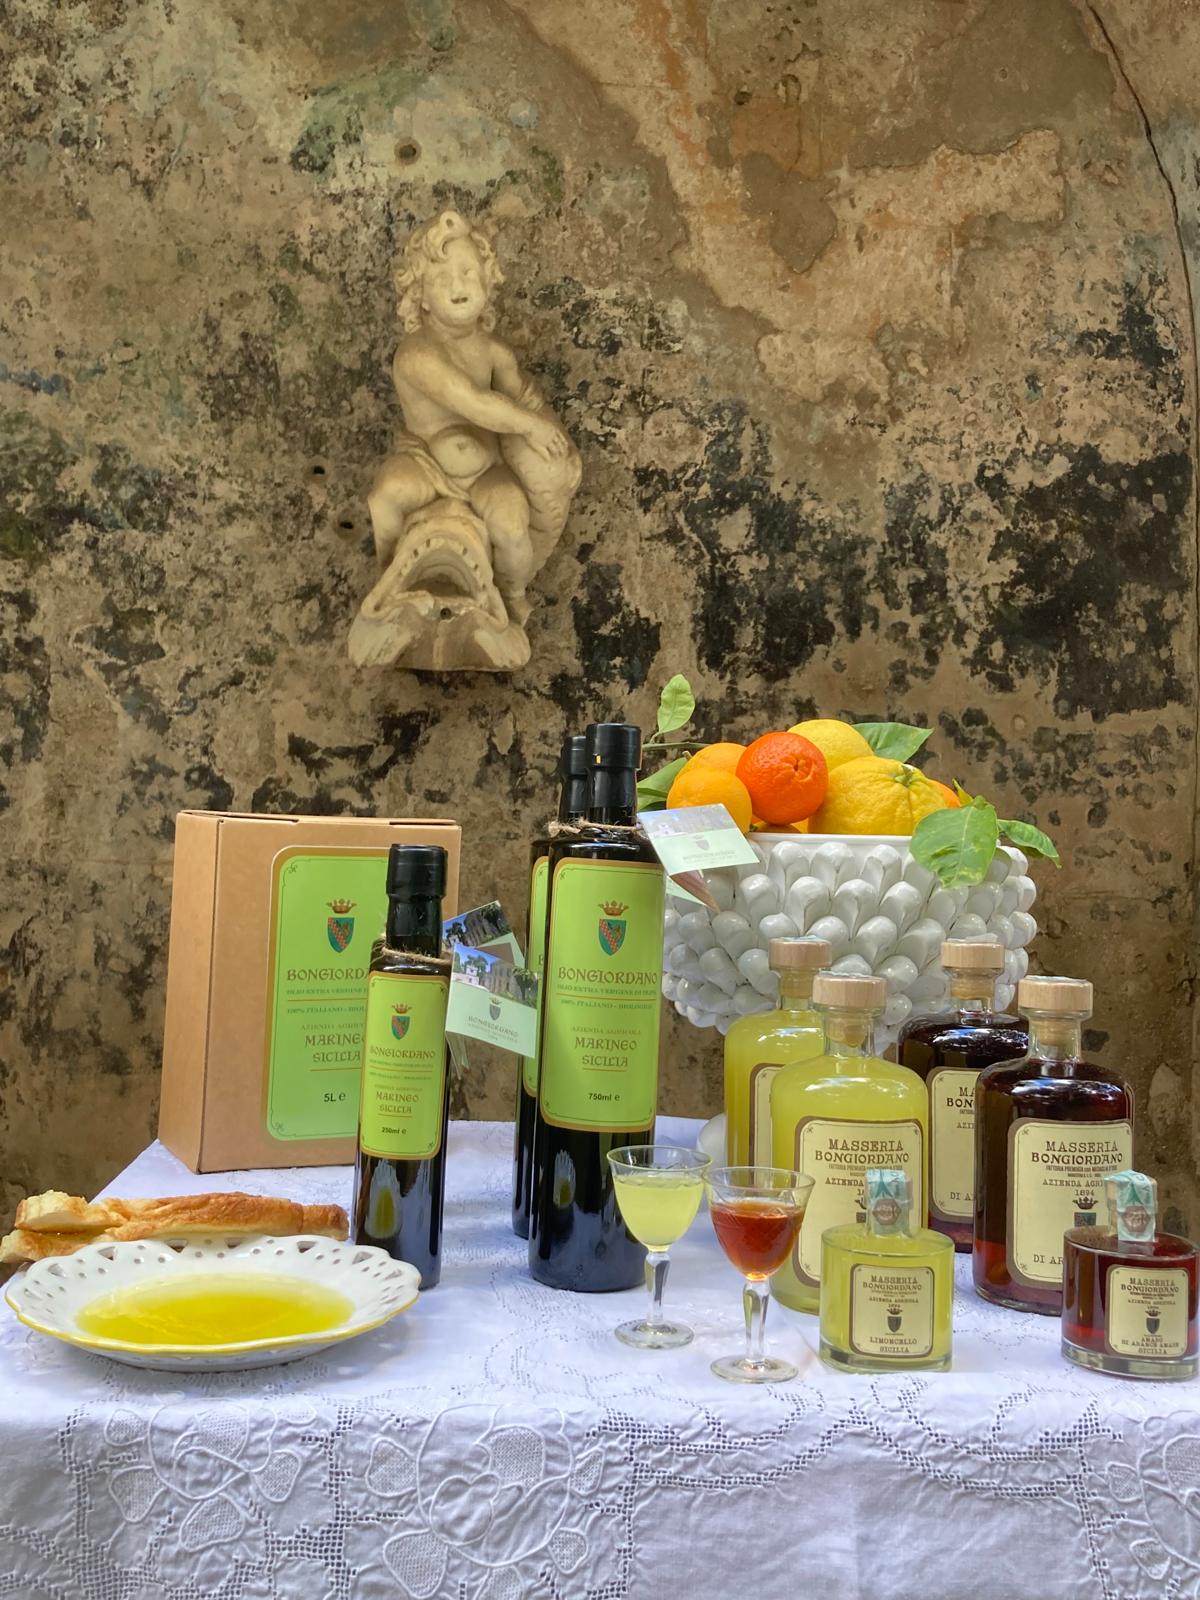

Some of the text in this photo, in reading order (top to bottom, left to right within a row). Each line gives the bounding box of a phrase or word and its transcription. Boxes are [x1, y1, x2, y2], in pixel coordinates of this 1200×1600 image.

[558, 966, 658, 986] BONGIORDANO
[575, 1036, 637, 1051] MARINEO
[313, 1051, 361, 1062] SICILIA
[370, 1045, 436, 1059] BONGIORDANO
[582, 1055, 628, 1067] SICILIA
[324, 1093, 337, 1103] 5L
[376, 1091, 420, 1102] MARINEO
[588, 1092, 612, 1101] 750ml
[379, 1104, 412, 1113] SICILIA
[828, 1138, 904, 1152] MASSERIA
[1046, 1141, 1118, 1153] MASSERIA
[815, 1150, 910, 1164] BONGIORDANO
[1031, 1152, 1123, 1165] BONGIORDANO
[825, 1177, 864, 1187] AZIENDA
[1043, 1179, 1082, 1187] AZIENDA
[1033, 1254, 1045, 1263] DI
[871, 1275, 919, 1284] MASSERIA
[1129, 1277, 1176, 1286] MASSERIA
[863, 1282, 922, 1291] BONGIORDANO
[1121, 1284, 1179, 1293] BONGIORDANO
[870, 1337, 917, 1345] LIMONCELLO
